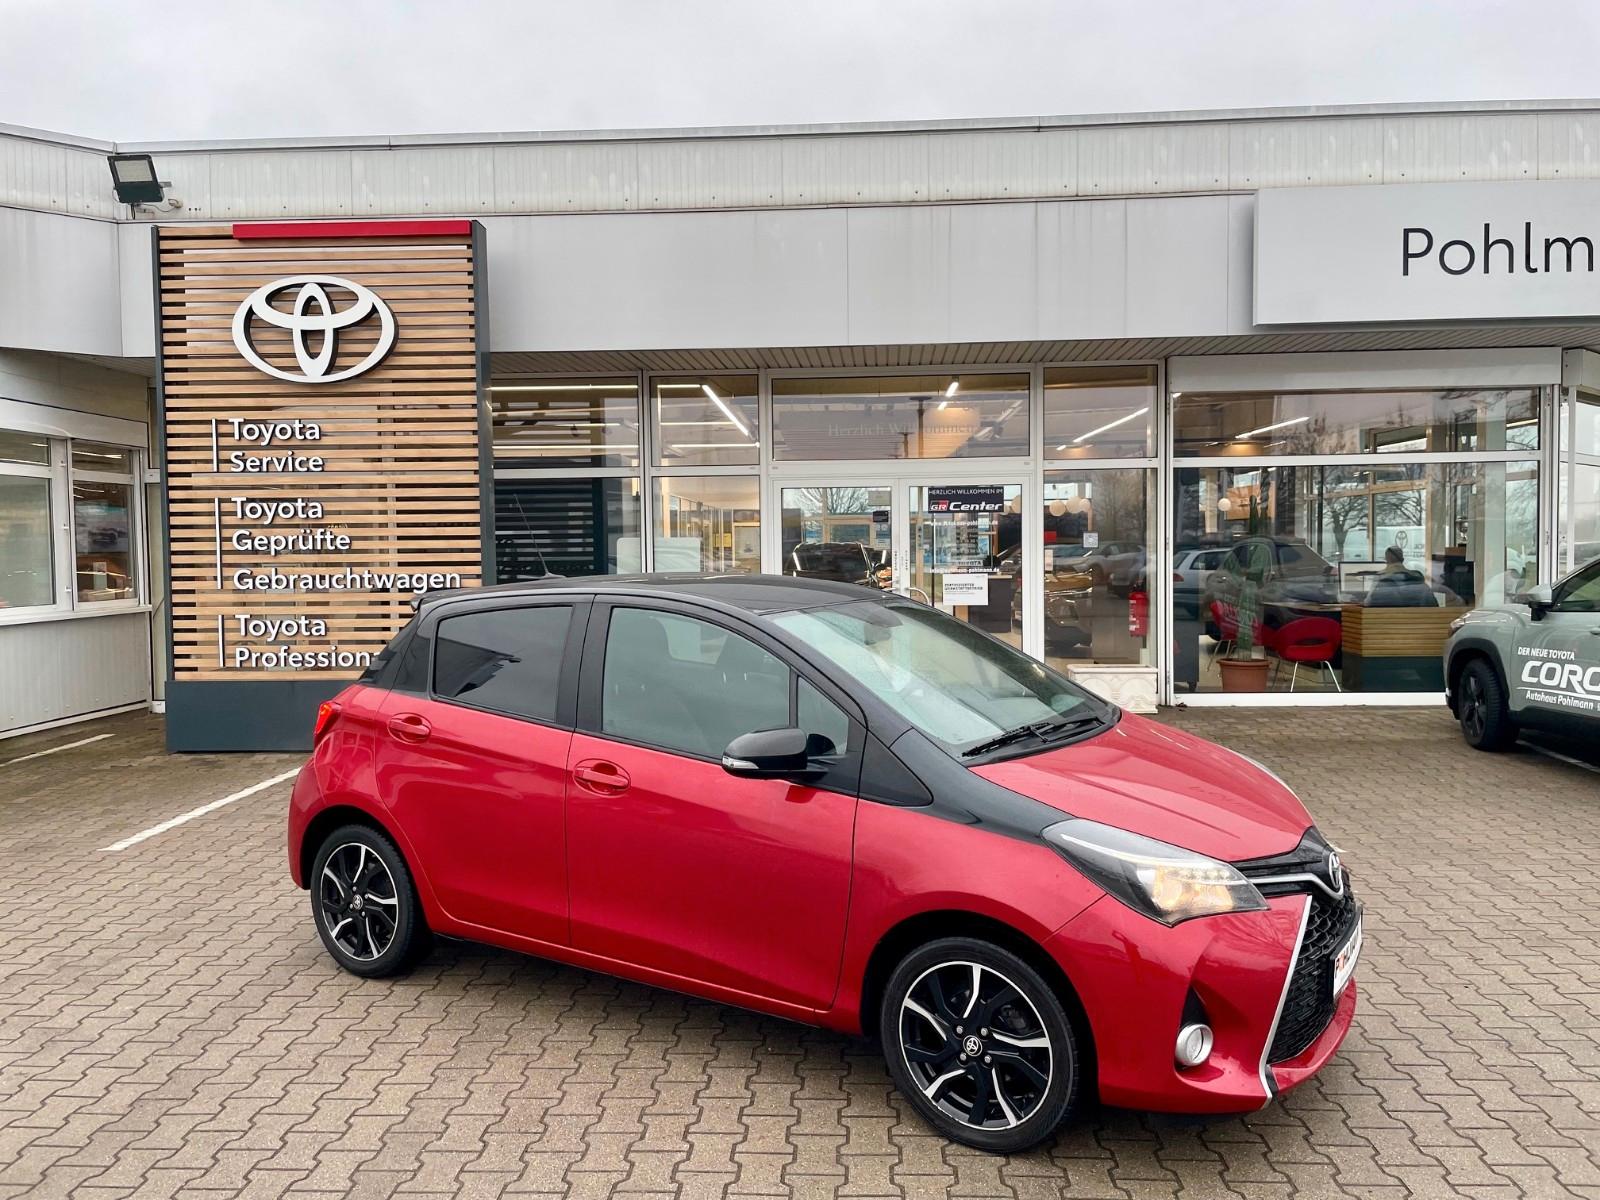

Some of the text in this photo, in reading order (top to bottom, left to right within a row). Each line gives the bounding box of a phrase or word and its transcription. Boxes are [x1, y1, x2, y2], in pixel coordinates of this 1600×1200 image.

[1402, 221, 1594, 276] Pohlm
[228, 418, 321, 446] Toyota
[230, 450, 325, 473] Service
[231, 497, 323, 525] Toyota
[949, 501, 1003, 511] Center
[231, 529, 351, 556] Geprüfte
[232, 568, 461, 594] Gebrauchtwagen
[234, 614, 327, 641] Toyota
[1518, 646, 1575, 660] DER NEUE TOYOTA
[1526, 690, 1557, 704] Autohaus
[1557, 695, 1594, 710] Pohlmann
